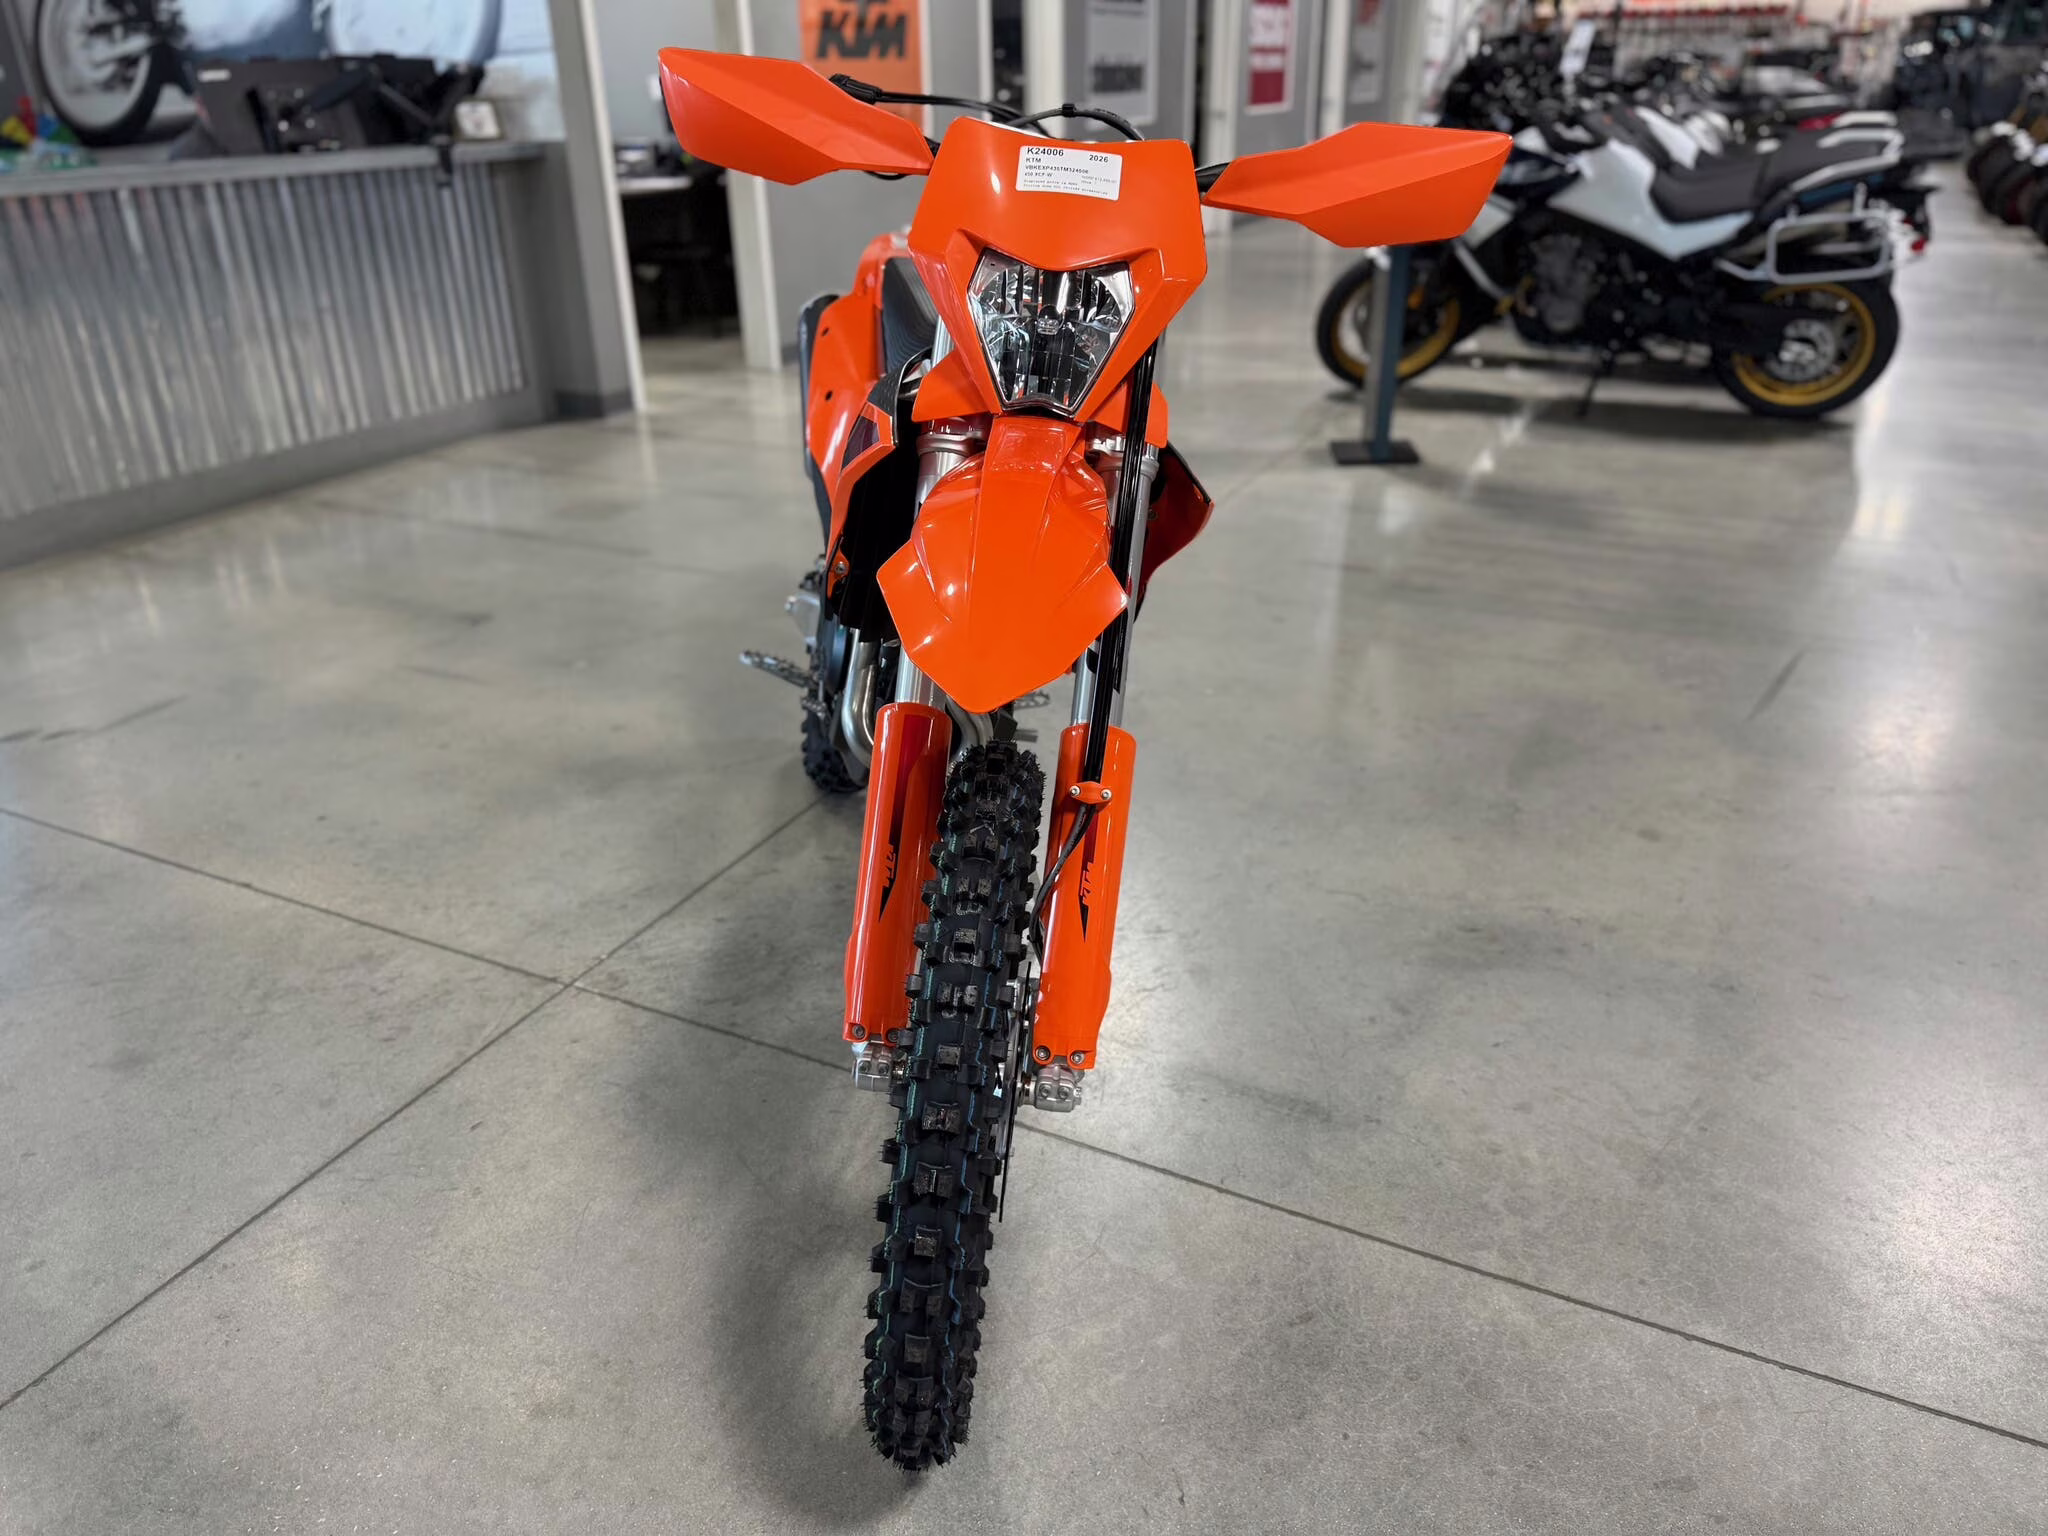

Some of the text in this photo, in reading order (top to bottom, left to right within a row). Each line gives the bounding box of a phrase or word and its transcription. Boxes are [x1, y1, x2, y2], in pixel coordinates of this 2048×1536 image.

[817, 0, 906, 58] KTM
[1027, 147, 1064, 157] K24006
[1089, 154, 1109, 163] 2026
